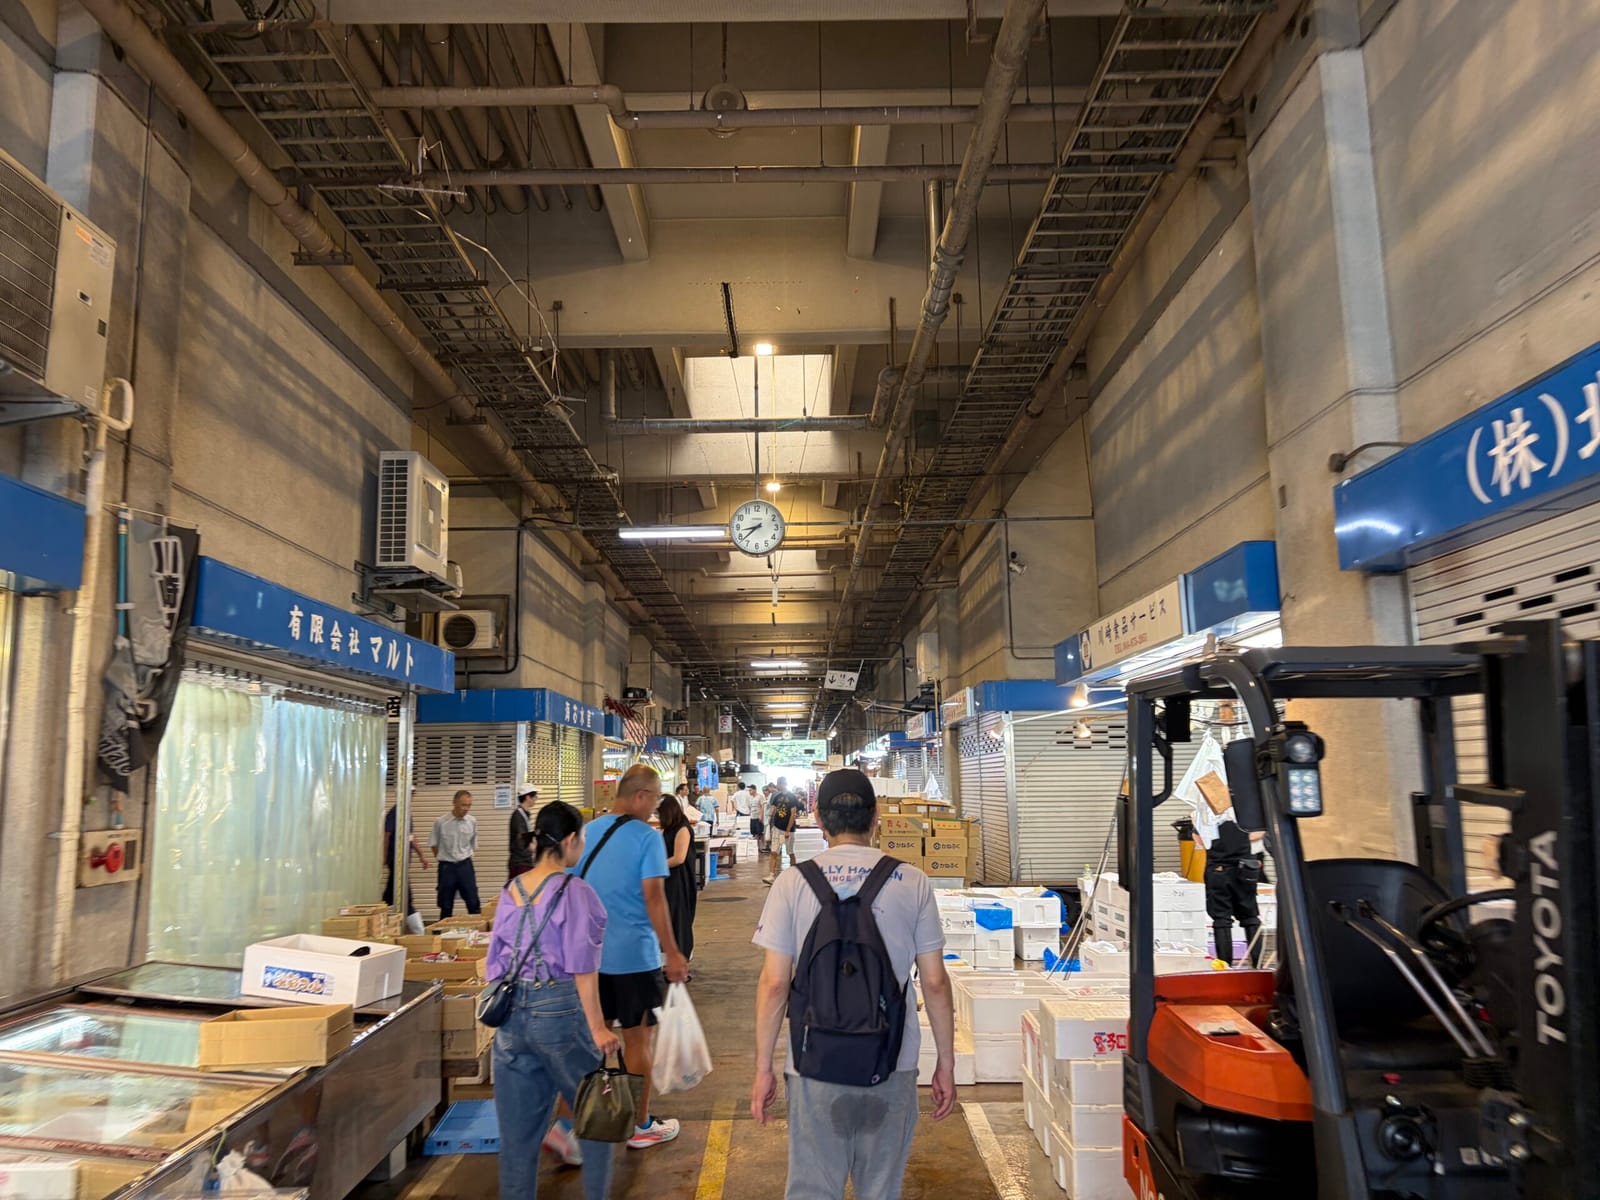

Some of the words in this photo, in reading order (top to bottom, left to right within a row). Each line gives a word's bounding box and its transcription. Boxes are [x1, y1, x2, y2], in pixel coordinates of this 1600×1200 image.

[288, 604, 414, 677] 有限会社マルト
[1530, 830, 1566, 1045] TOYOTA
